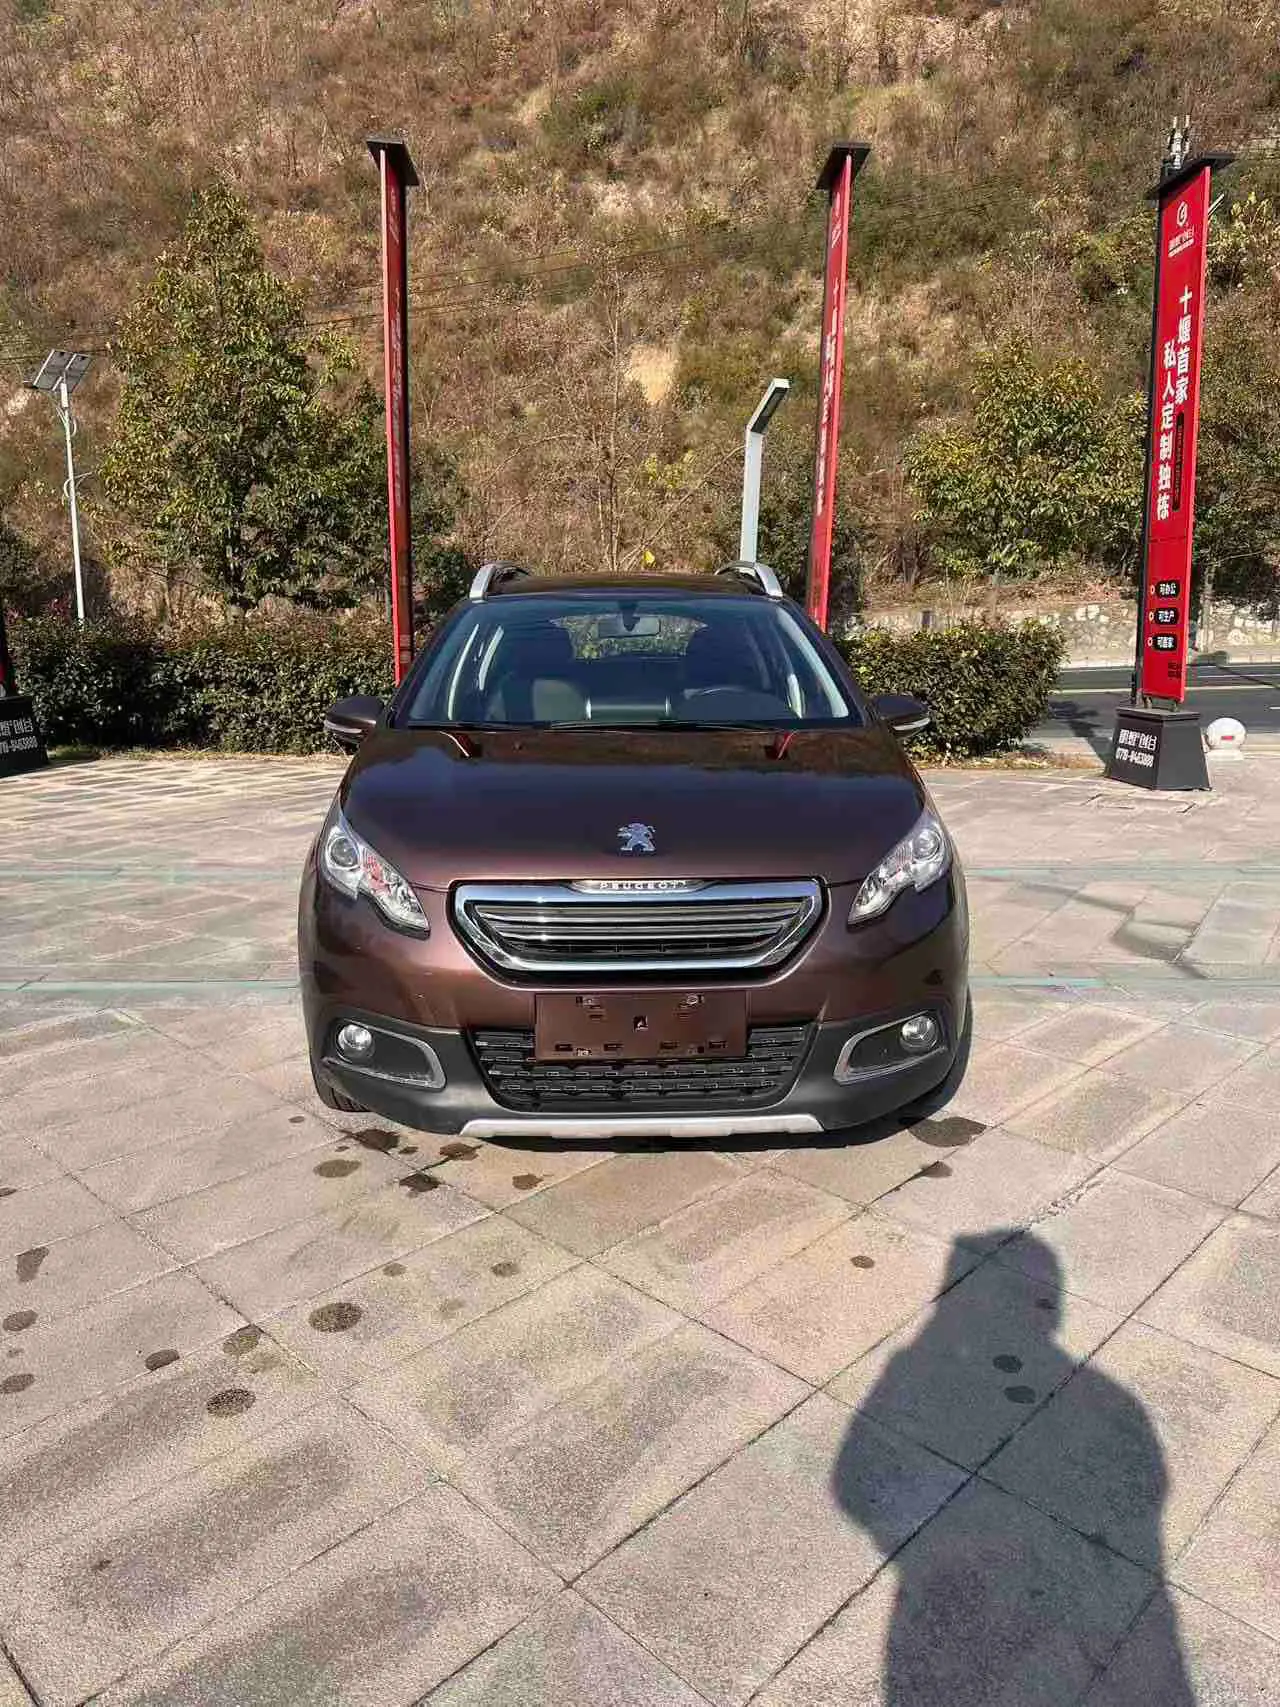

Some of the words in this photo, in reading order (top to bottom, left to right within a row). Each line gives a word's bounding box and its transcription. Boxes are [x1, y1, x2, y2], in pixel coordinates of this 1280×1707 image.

[1175, 284, 1193, 404] 十堰首家
[600, 879, 687, 890] PEUGEOT
